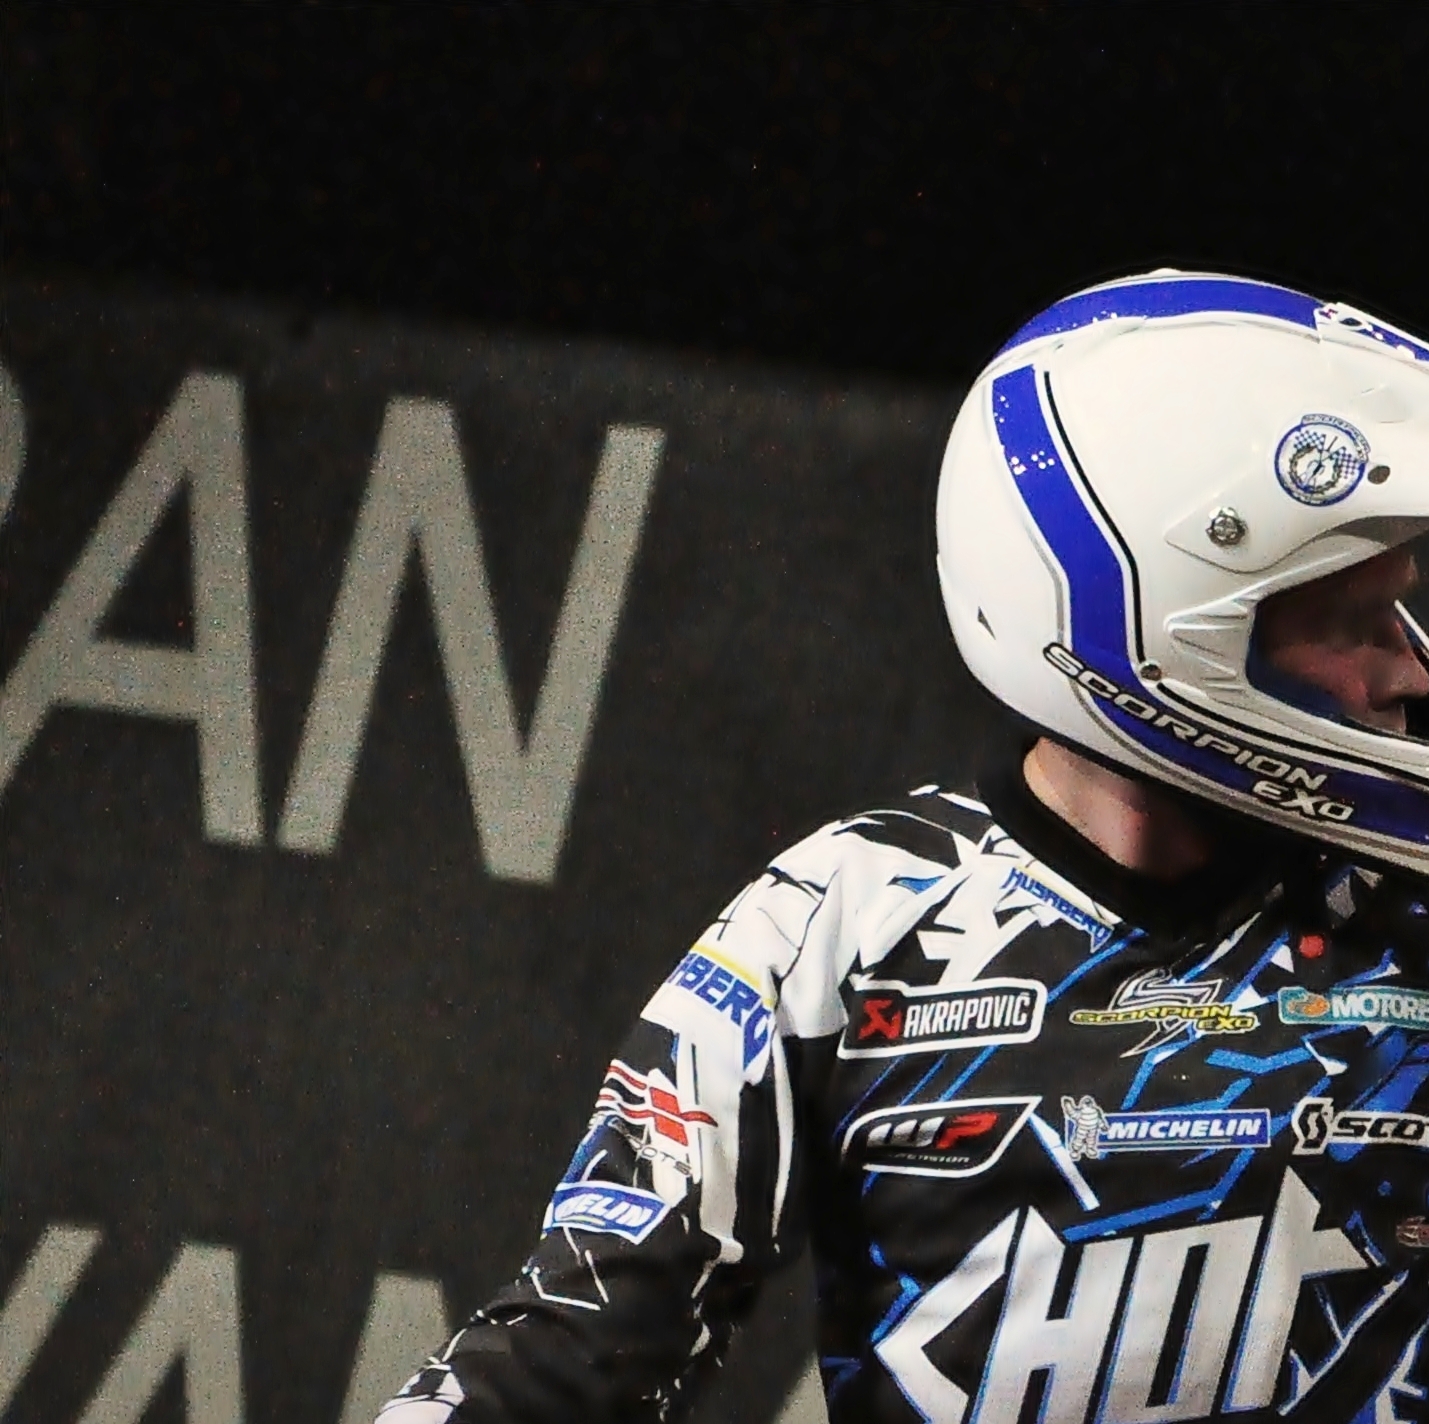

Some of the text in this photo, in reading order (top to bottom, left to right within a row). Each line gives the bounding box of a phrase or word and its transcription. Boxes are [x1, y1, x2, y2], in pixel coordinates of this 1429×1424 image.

[0, 365, 667, 885] AN
[1044, 642, 1327, 790] SCORPION
[1250, 778, 1355, 822] EXO
[1108, 1116, 1263, 1142] MICHELIN
